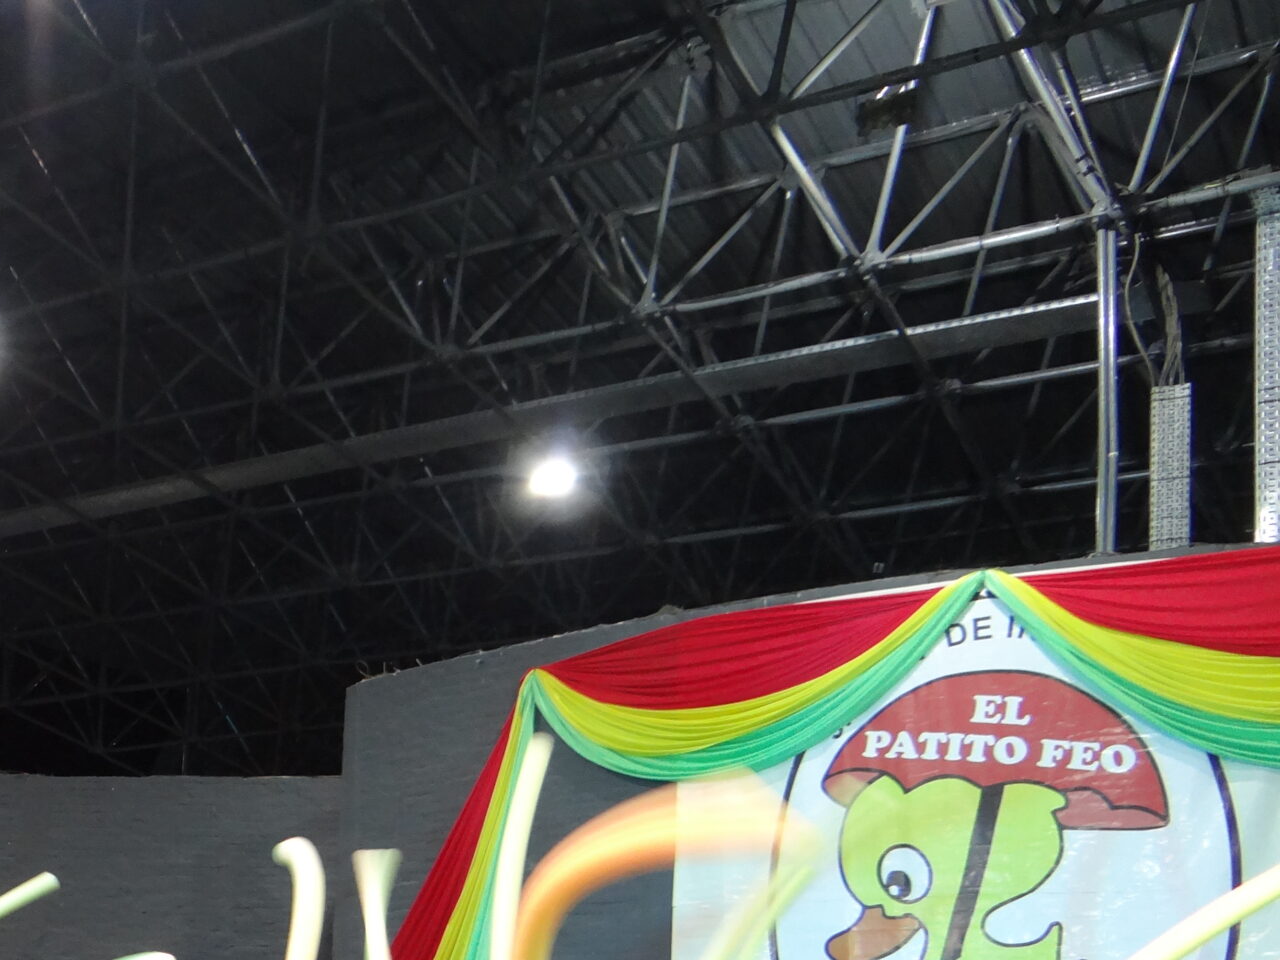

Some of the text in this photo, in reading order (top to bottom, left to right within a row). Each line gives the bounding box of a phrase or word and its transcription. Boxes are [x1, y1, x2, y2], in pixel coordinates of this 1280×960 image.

[944, 616, 993, 647] DE
[970, 695, 1032, 725] EL
[861, 730, 1028, 765] PATITO
[1036, 739, 1137, 773] FEO
